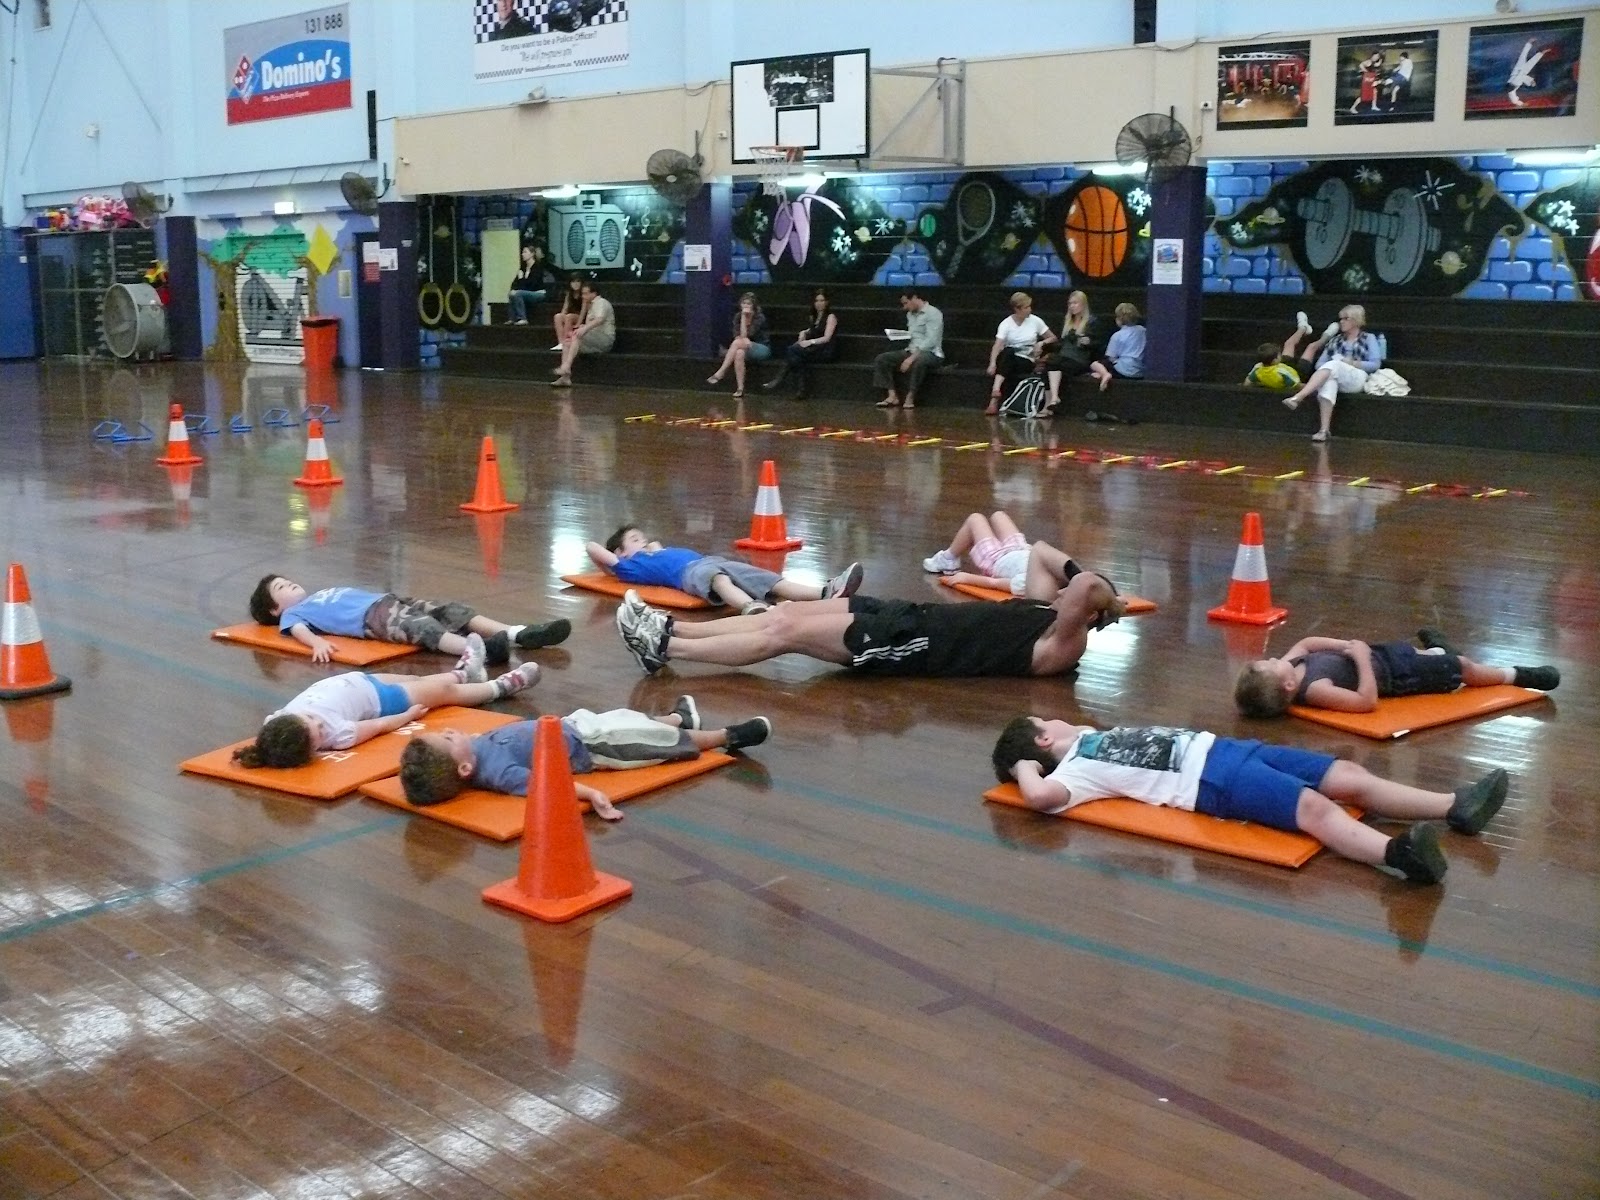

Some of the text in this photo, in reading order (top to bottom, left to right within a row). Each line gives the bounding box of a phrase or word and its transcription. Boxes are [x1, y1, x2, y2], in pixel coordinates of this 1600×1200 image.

[305, 13, 343, 33] 131 888
[510, 43, 520, 52] you
[556, 35, 573, 43] Police
[575, 31, 597, 41] Officer?
[261, 49, 341, 90] Domino's
